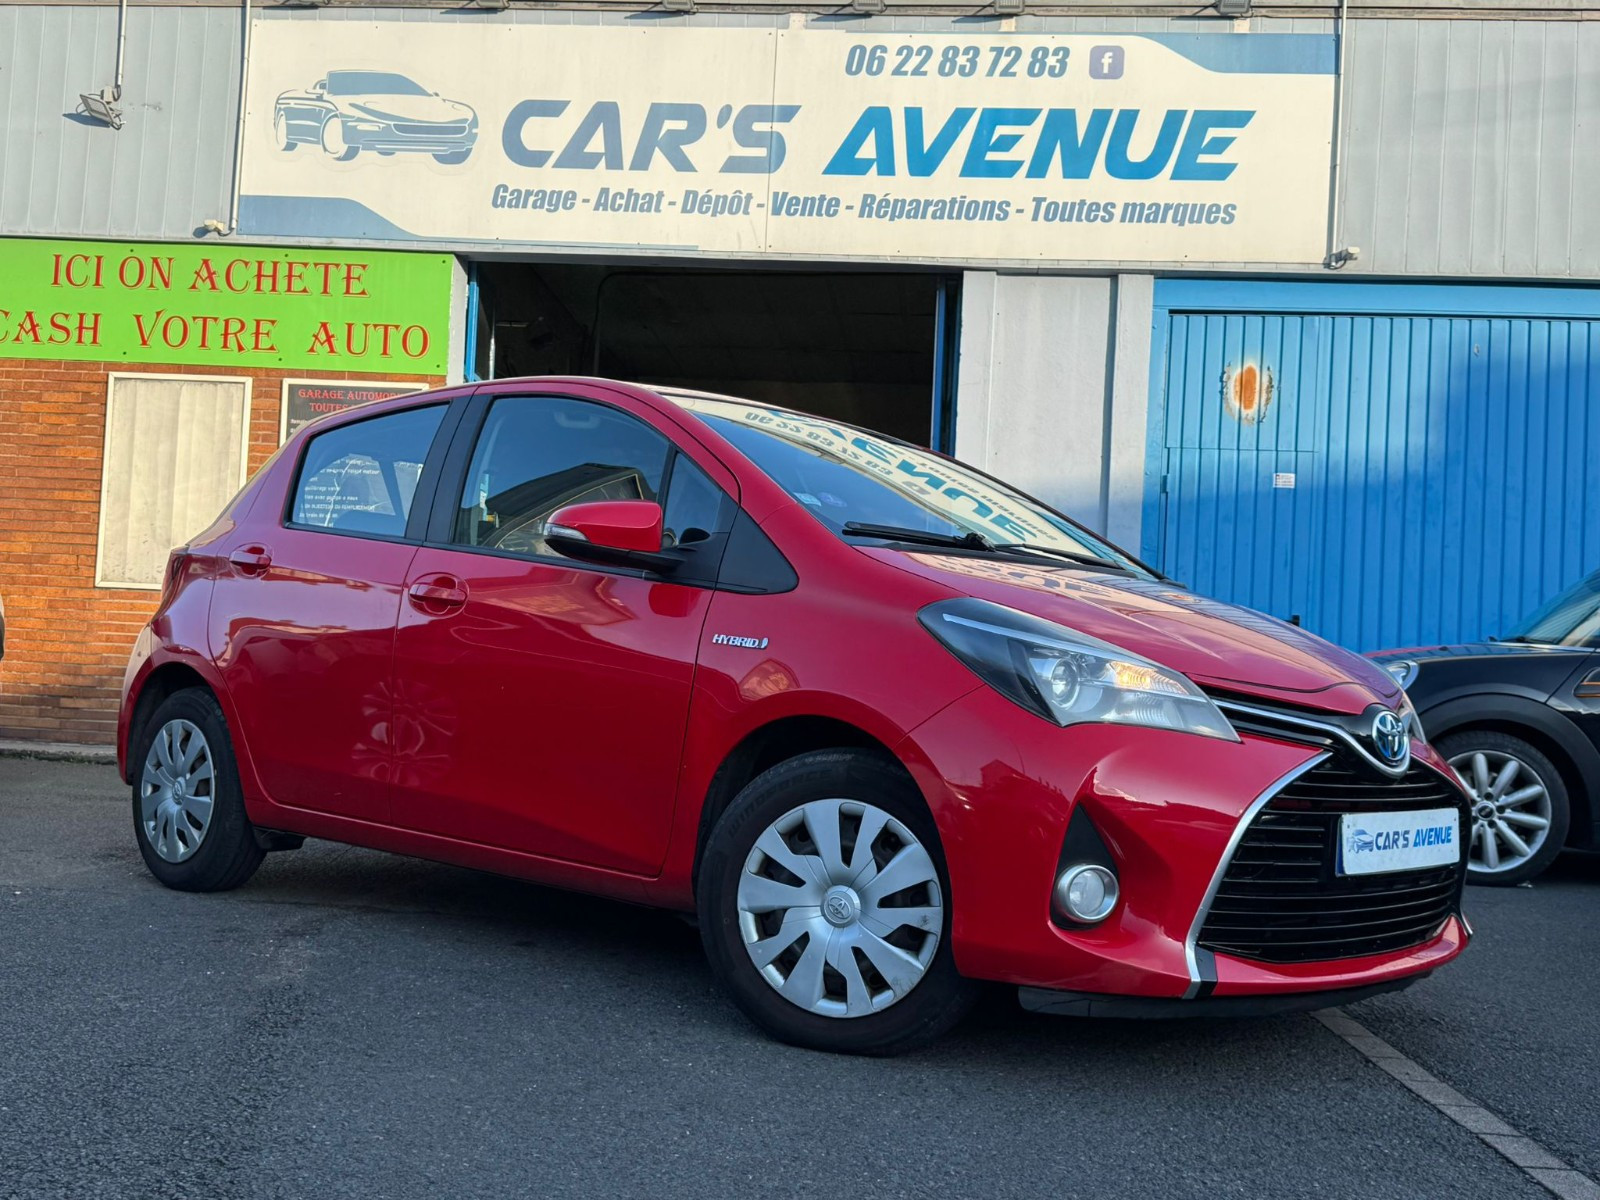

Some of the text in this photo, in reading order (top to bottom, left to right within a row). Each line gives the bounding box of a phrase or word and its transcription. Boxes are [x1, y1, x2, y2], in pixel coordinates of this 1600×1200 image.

[844, 44, 1071, 79] 06 22 83 72 83
[501, 99, 1257, 182] CAR'S AVENUE
[491, 183, 578, 214] Garage
[593, 187, 665, 214] Achat
[681, 189, 754, 218] Dépôt
[770, 191, 841, 218] Vente
[858, 193, 1012, 223] Réparations
[1031, 196, 1117, 224] Toutes
[1119, 201, 1238, 228] marques
[51, 254, 369, 298] ICI ON ACHETE
[134, 309, 279, 353] VOTRE
[307, 321, 430, 358] AUTO
[298, 389, 344, 400] GARAGE
[712, 633, 759, 648] HYBRID
[1375, 825, 1453, 851] CAR'S AVENUE
